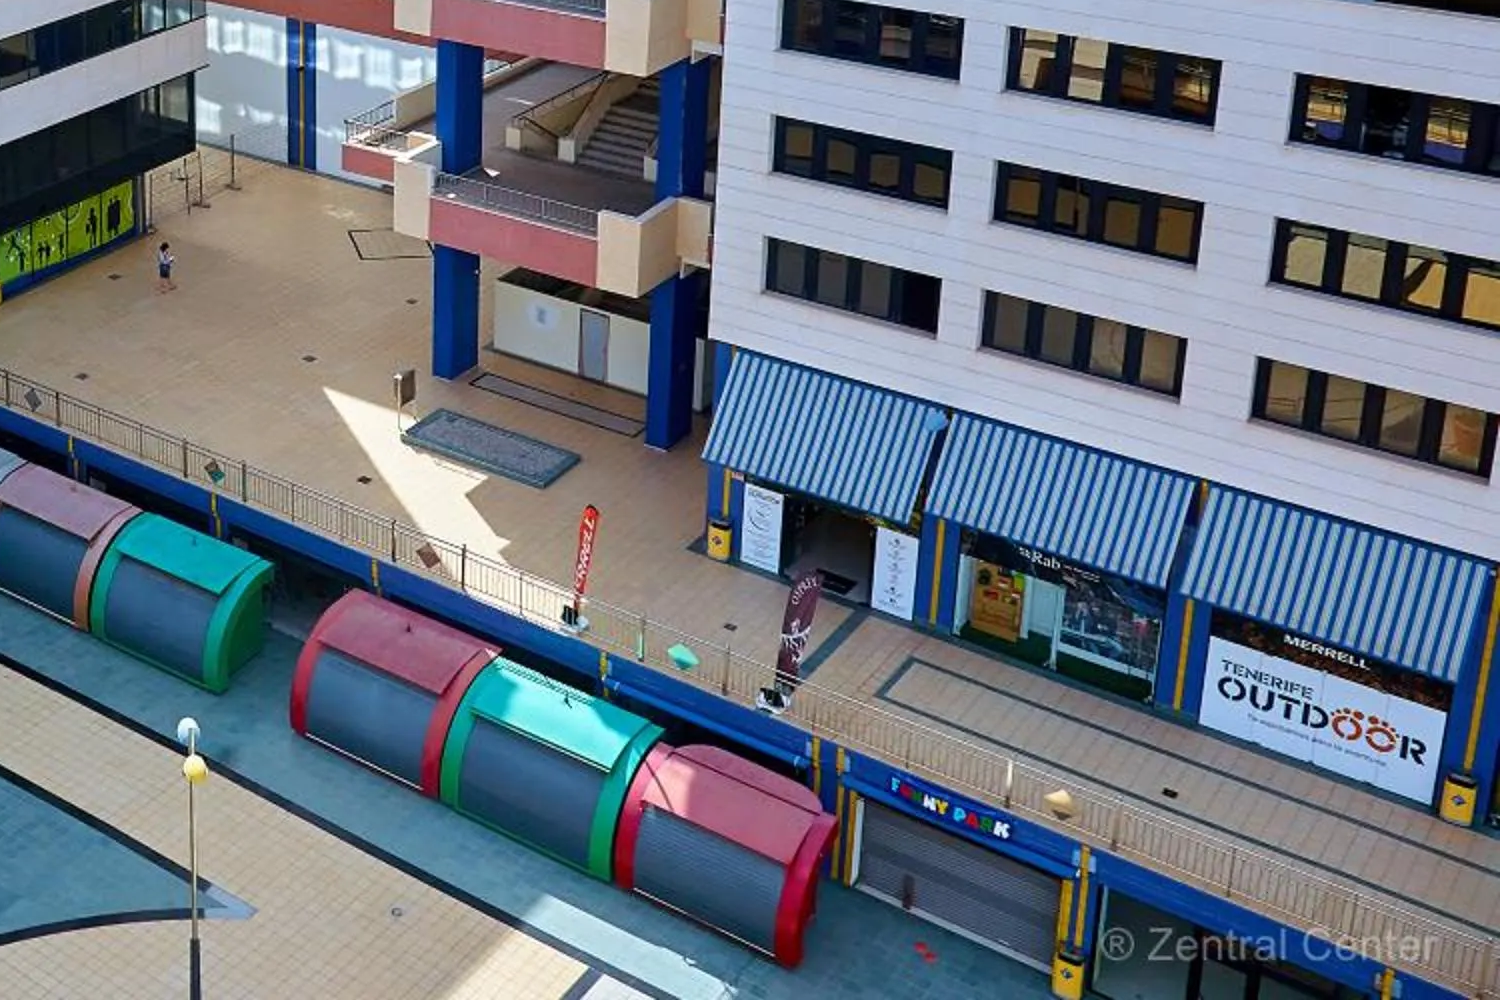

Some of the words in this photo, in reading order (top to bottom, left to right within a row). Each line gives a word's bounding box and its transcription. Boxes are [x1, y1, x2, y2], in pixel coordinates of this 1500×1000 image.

[1032, 551, 1061, 570] Rab
[1283, 634, 1370, 671] MERRELL
[1221, 659, 1314, 701] TENERIFE
[1217, 676, 1427, 767] OUTDOOR
[953, 807, 1011, 840] PARK
